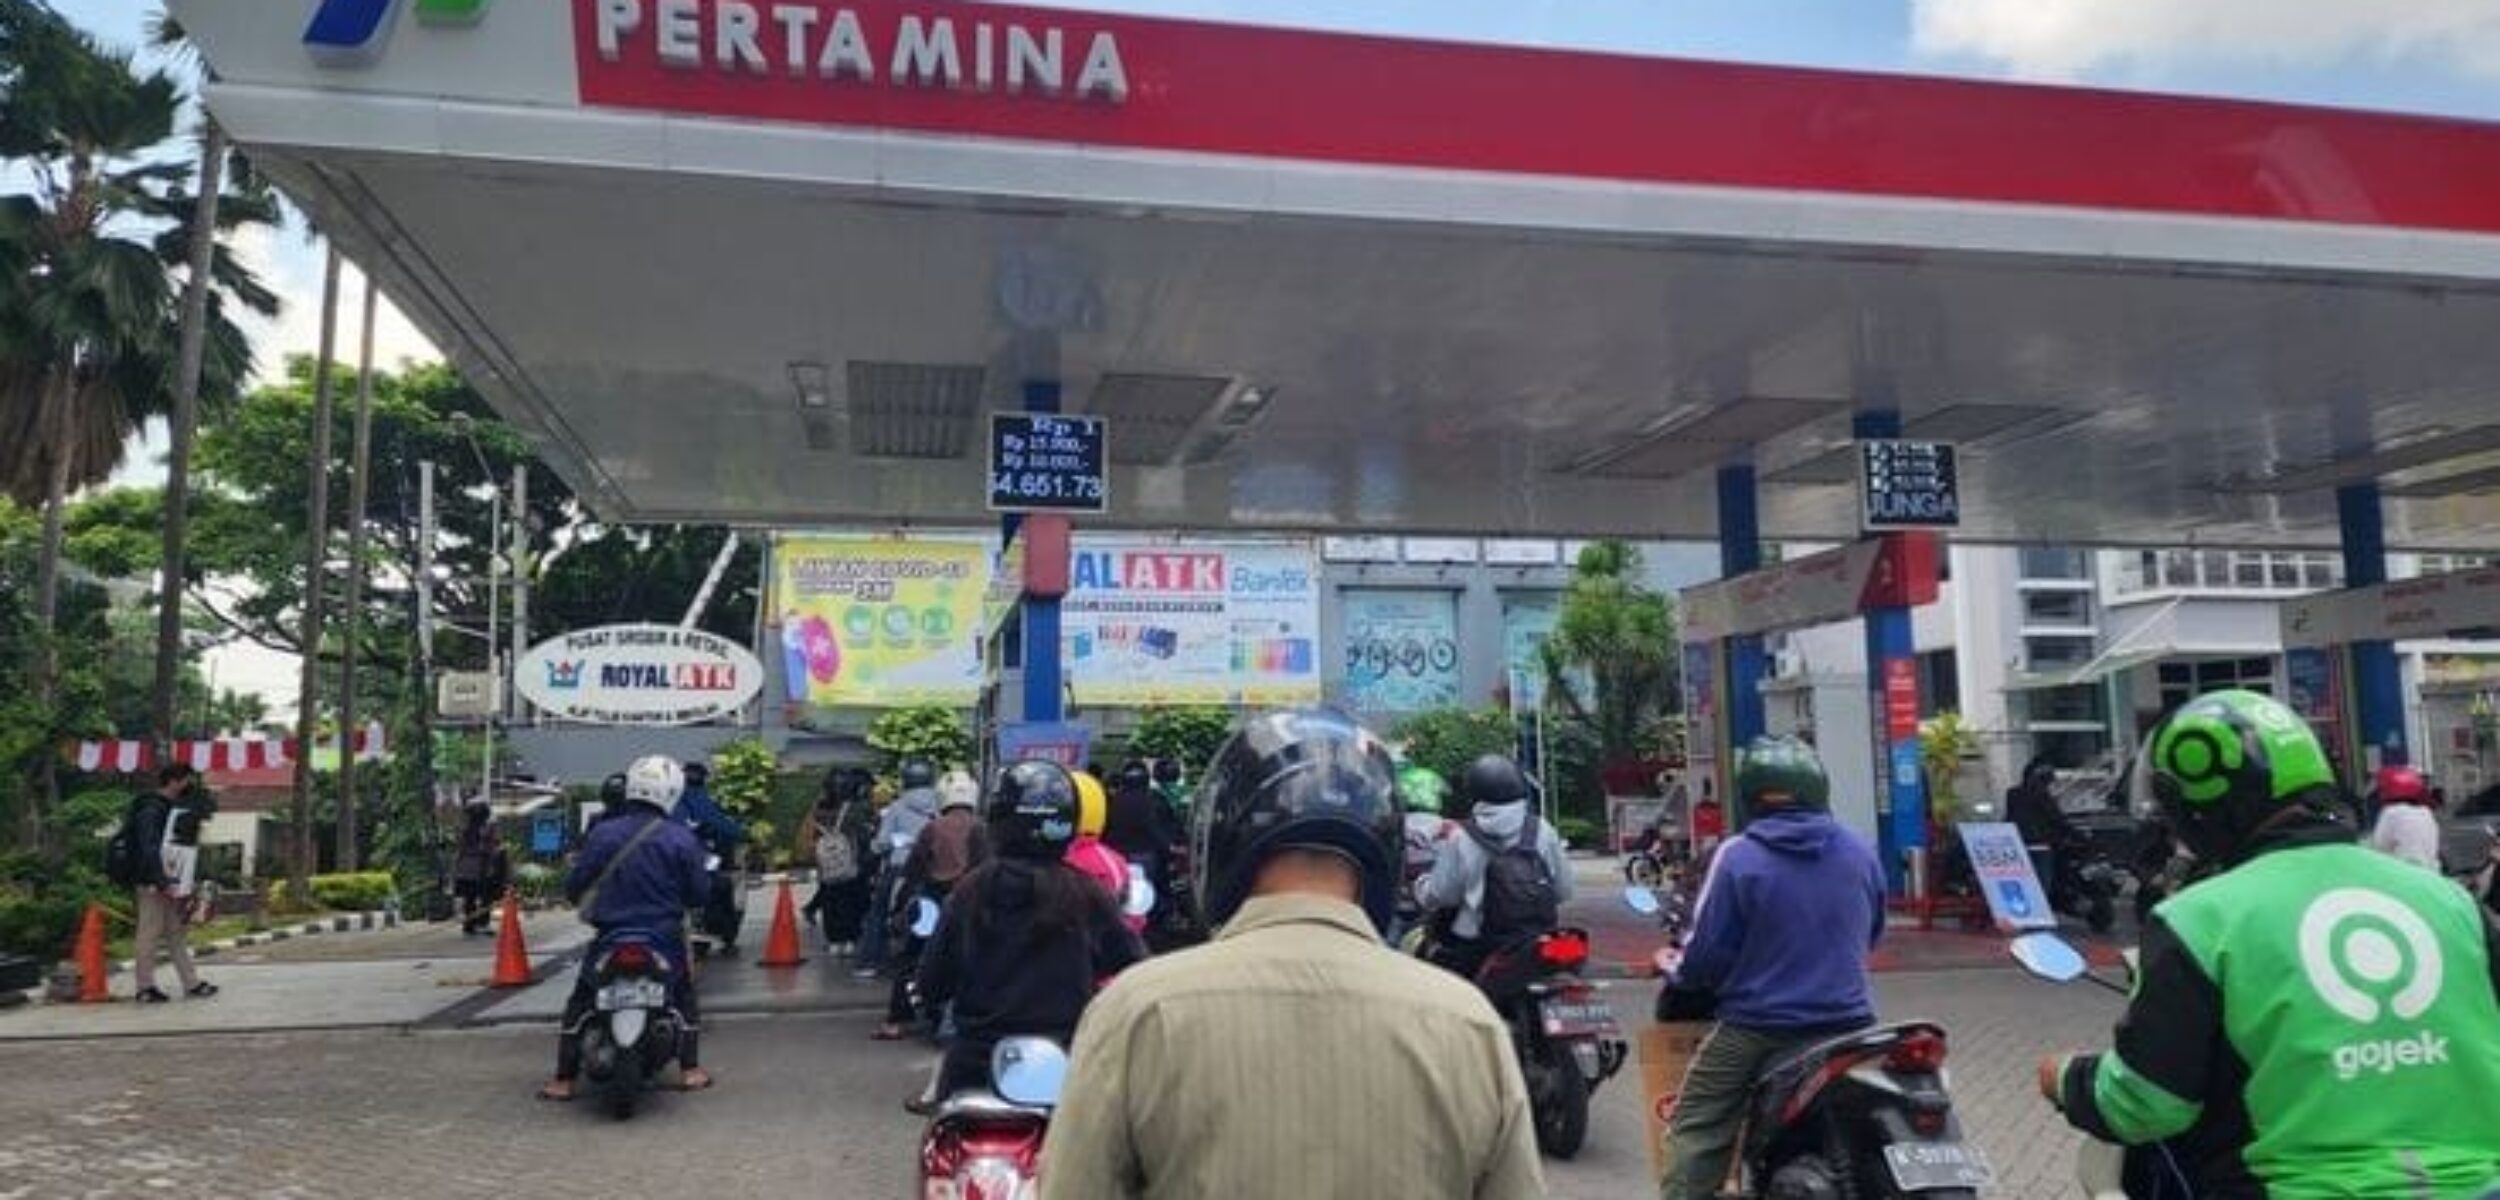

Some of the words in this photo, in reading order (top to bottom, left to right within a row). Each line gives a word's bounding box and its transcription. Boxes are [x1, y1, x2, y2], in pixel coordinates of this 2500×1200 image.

[596, 0, 1128, 99] PERTAMINA
[1130, 555, 1222, 590] ATK
[567, 631, 610, 650] PUSAT
[601, 664, 671, 688] ROYAL
[678, 664, 735, 689] ATK
[2333, 1029, 2450, 1082] gojek
